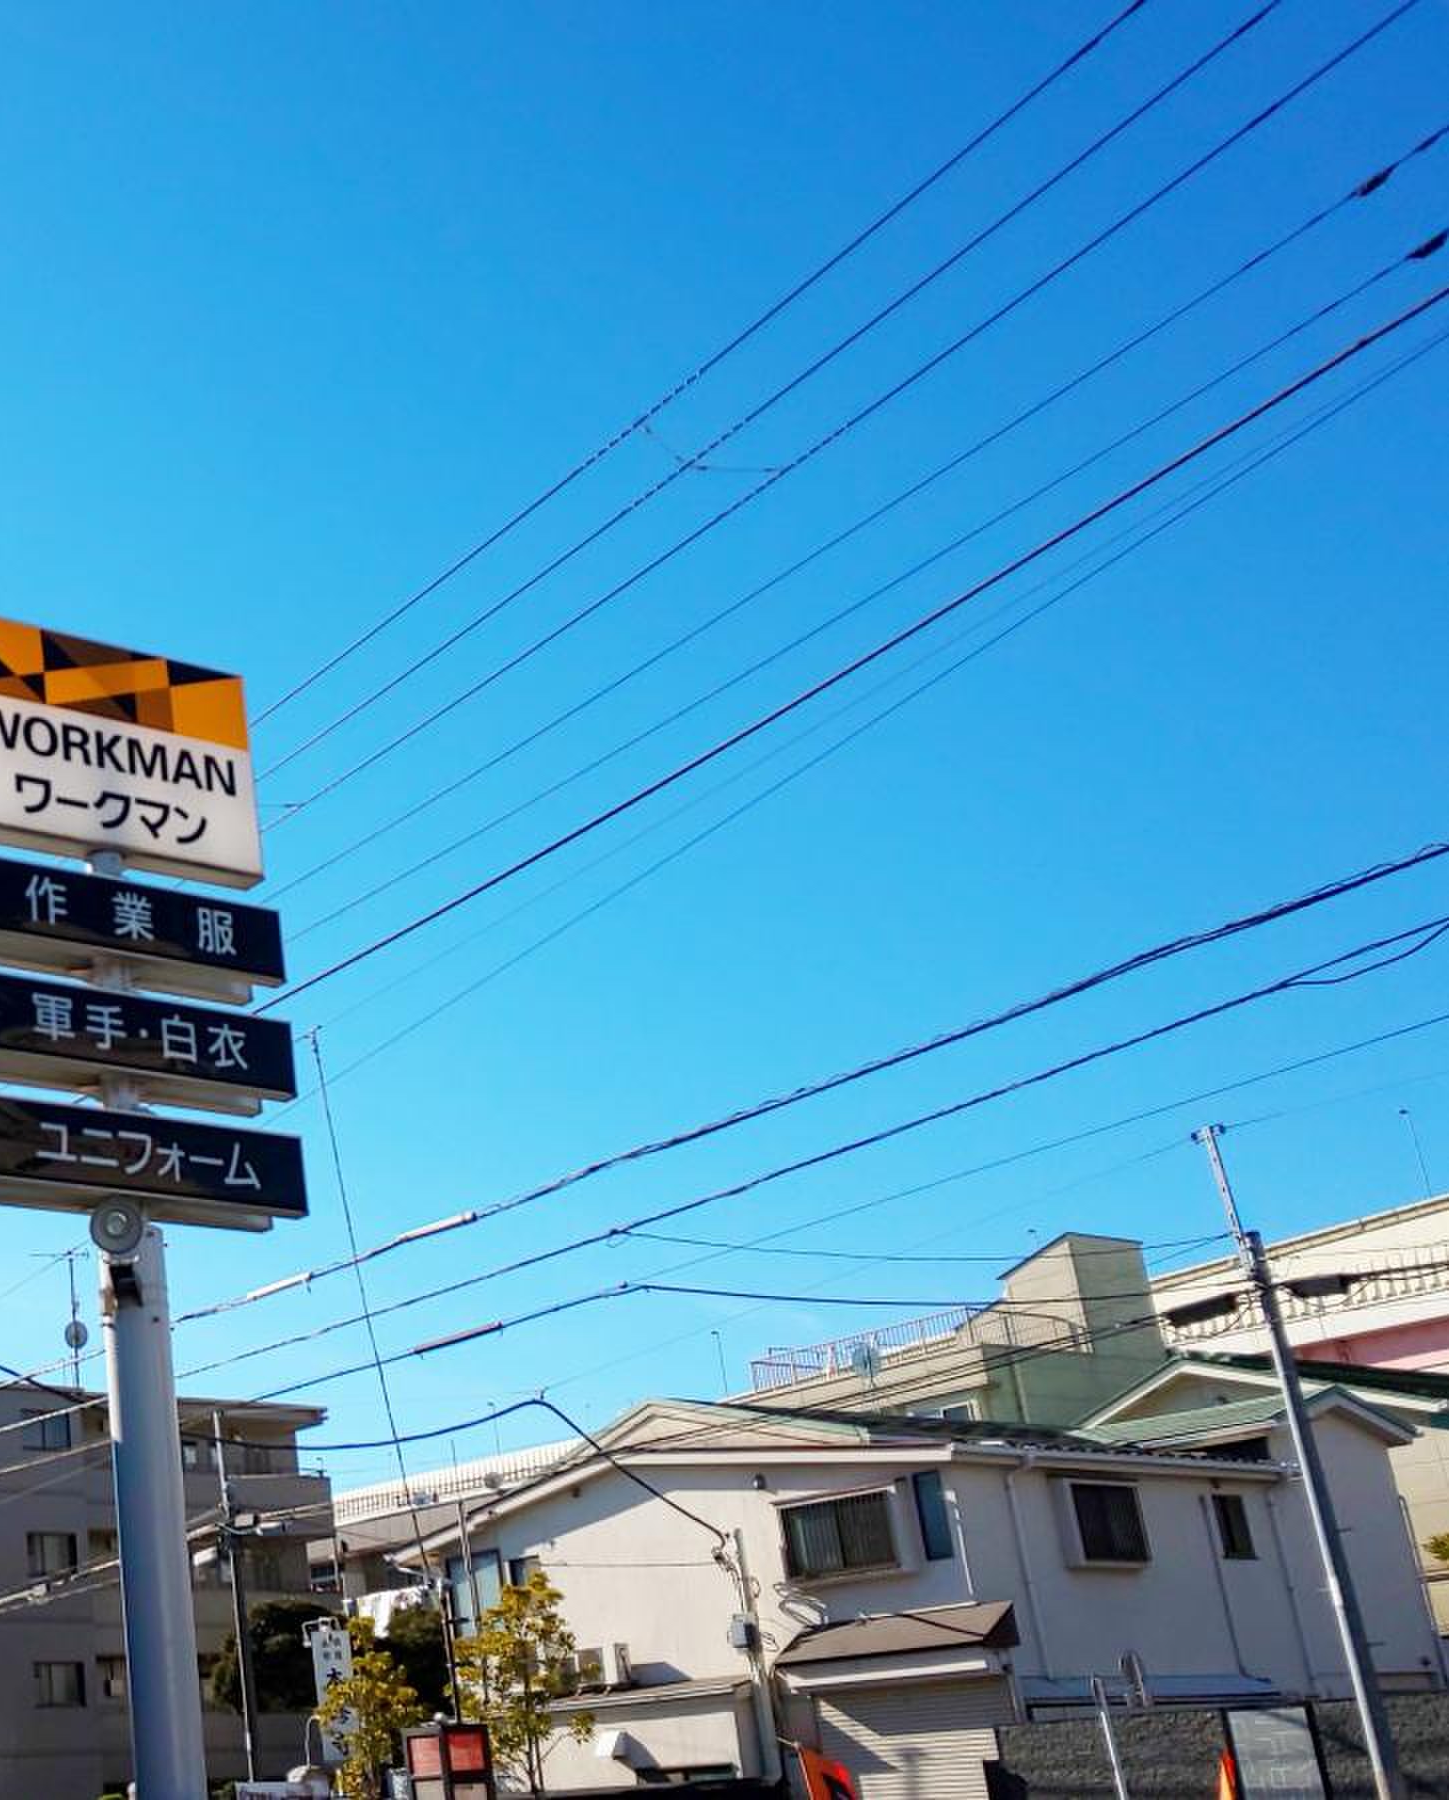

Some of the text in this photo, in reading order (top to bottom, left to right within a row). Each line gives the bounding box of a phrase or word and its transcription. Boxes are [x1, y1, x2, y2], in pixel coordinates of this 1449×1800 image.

[15, 774, 207, 845] ワークマン
[25, 874, 237, 956] 作業服
[35, 1121, 262, 1190] ユニフォーム
